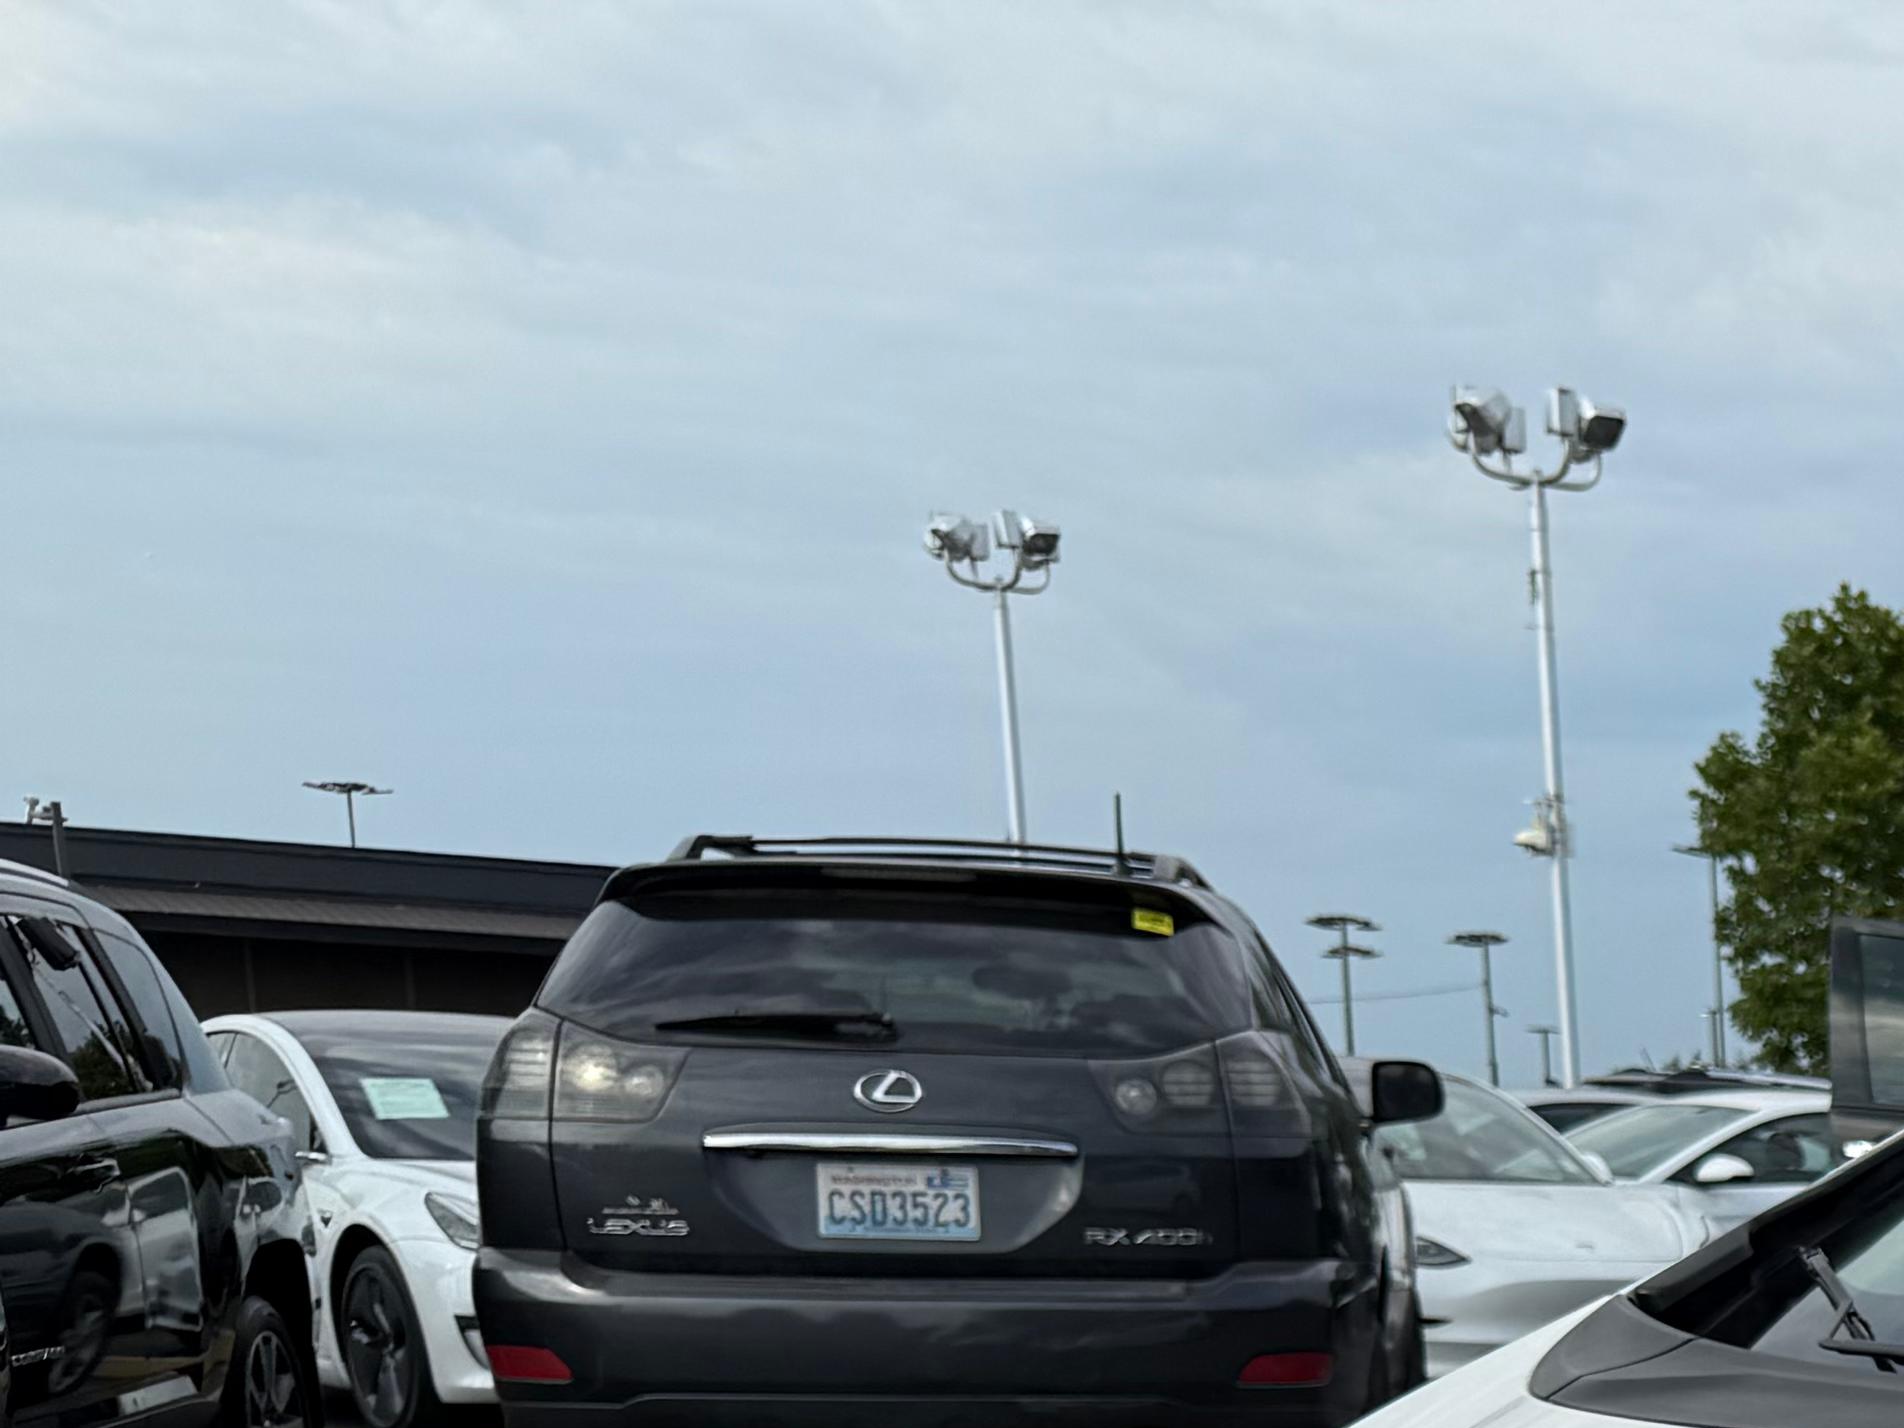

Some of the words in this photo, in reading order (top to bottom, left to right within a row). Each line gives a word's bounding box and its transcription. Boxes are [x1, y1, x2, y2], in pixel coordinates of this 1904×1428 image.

[828, 1189, 971, 1228] CSD3523
[586, 1217, 690, 1236] LEXUS
[1082, 1226, 1131, 1246] RX
